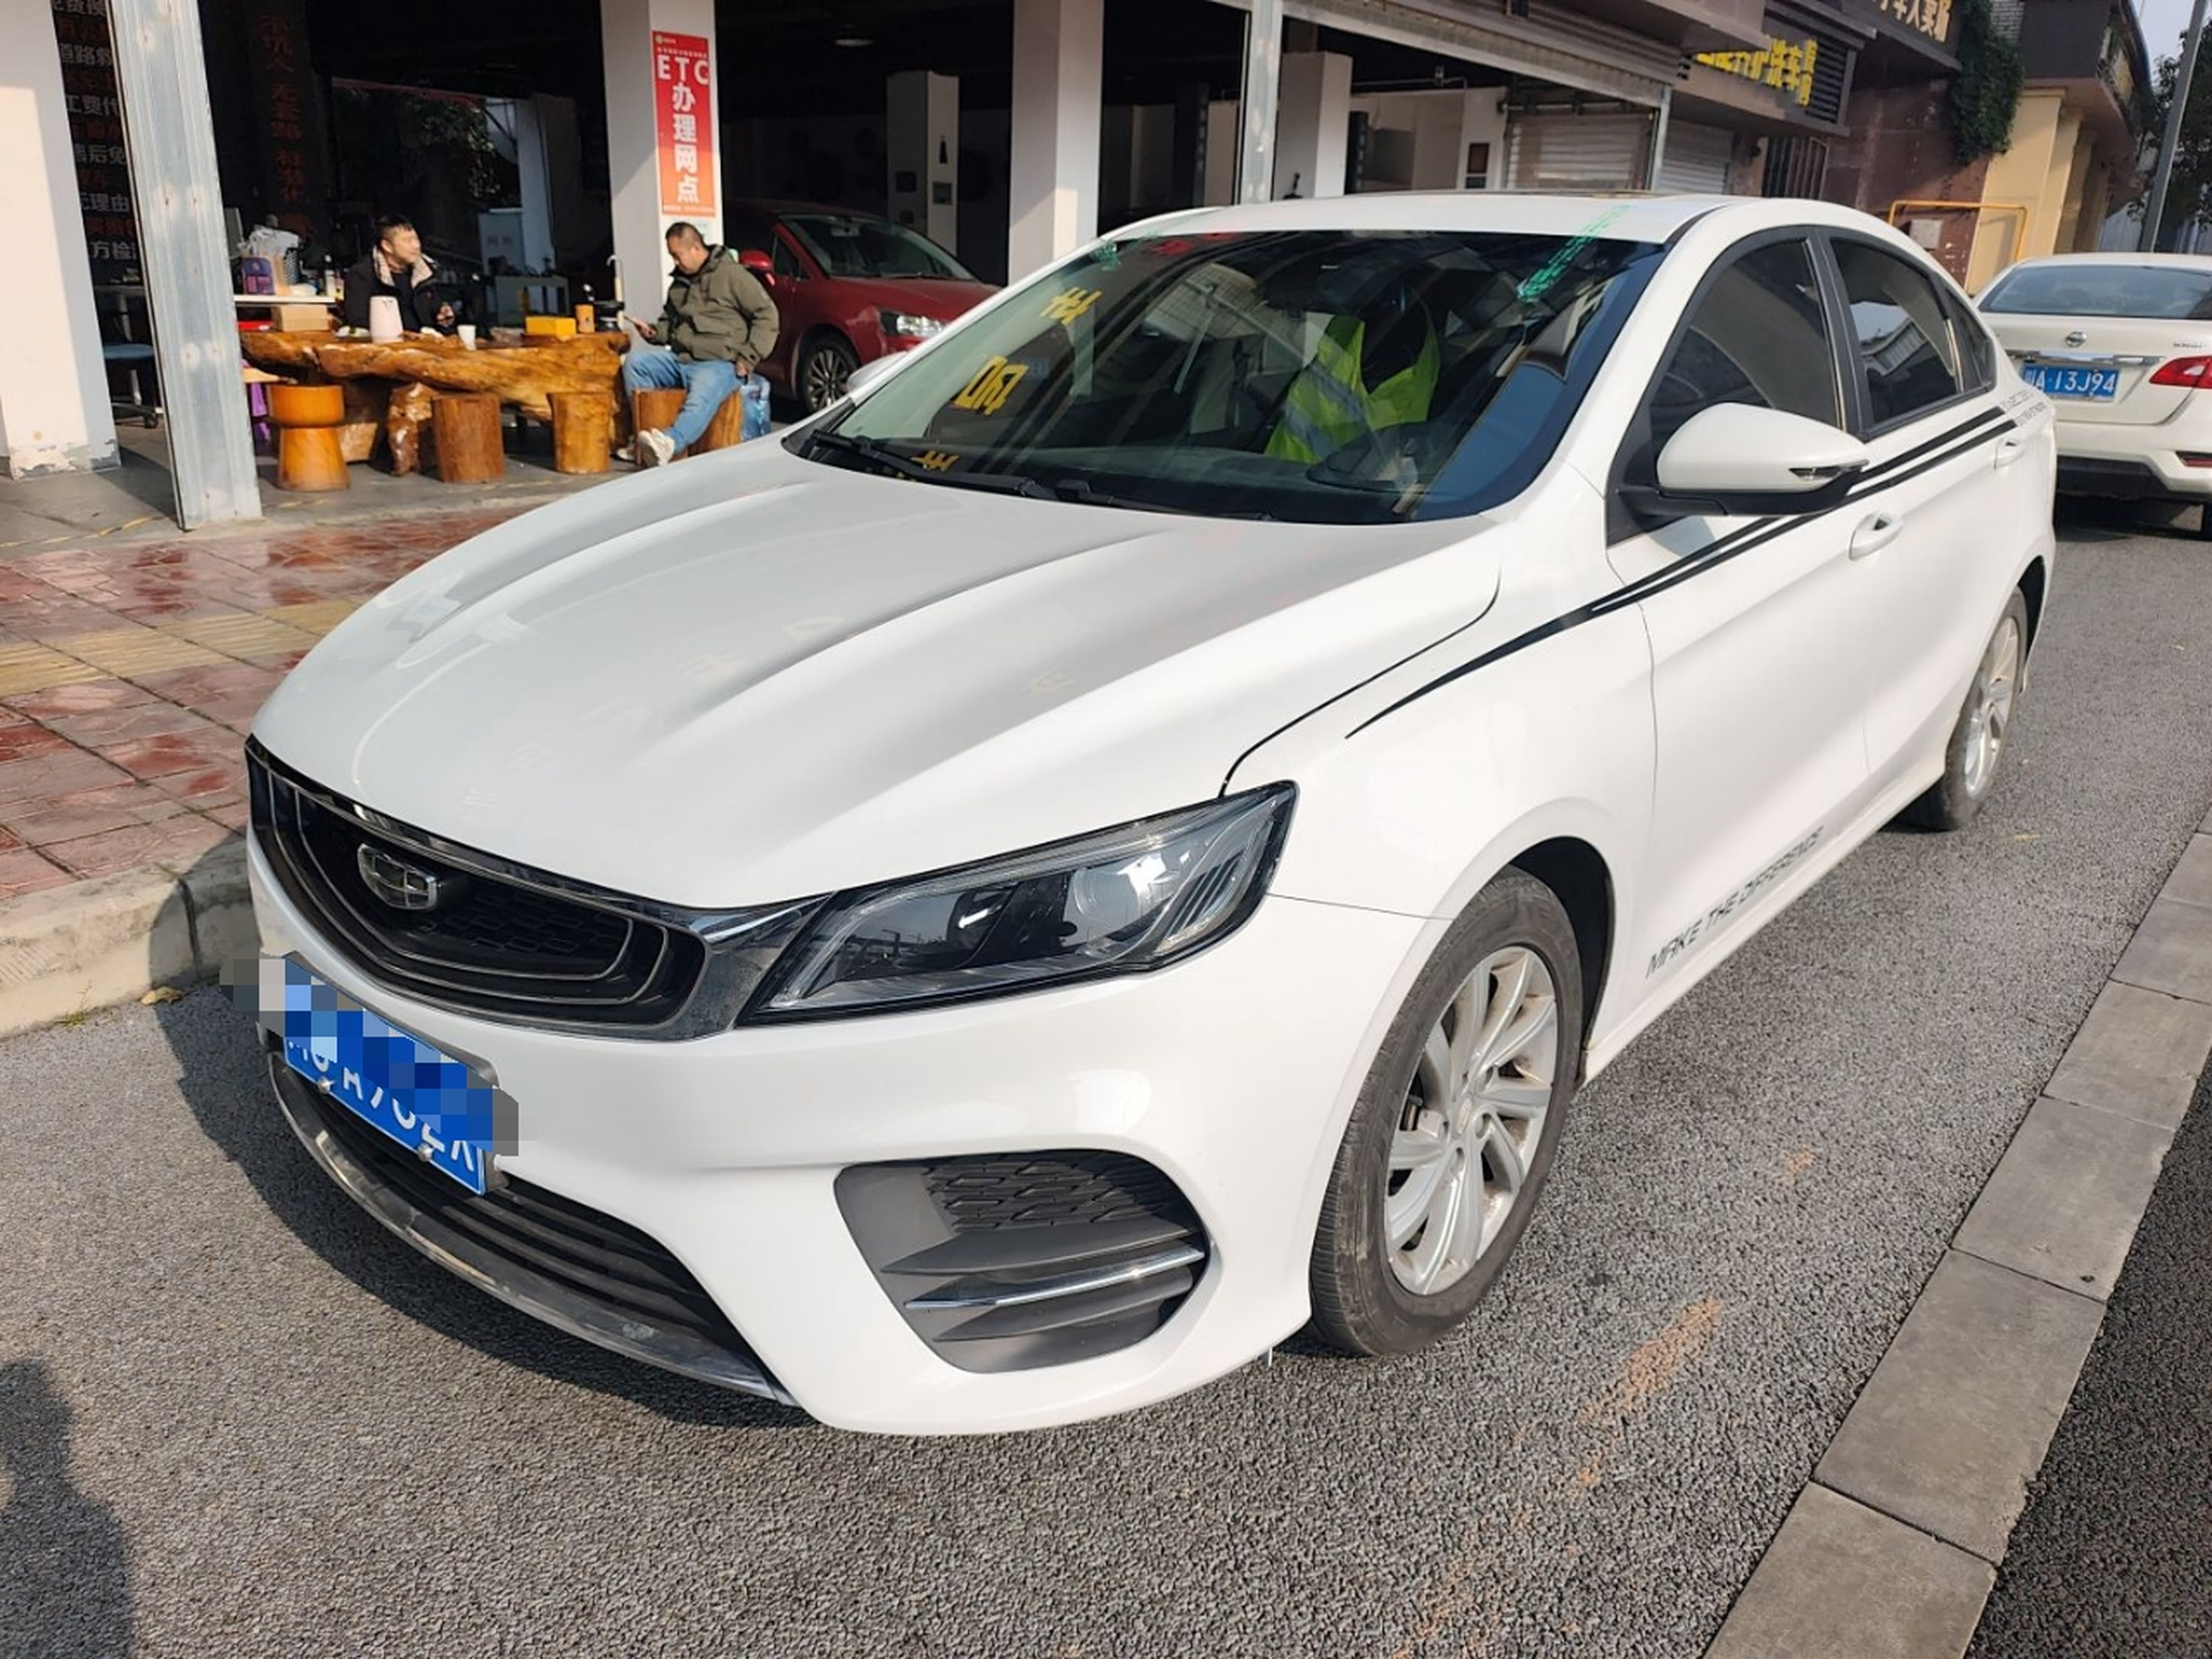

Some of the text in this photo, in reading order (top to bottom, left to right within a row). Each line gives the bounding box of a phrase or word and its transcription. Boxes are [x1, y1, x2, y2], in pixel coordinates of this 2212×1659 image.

[657, 54, 709, 85] ETC
[672, 82, 699, 204] 办理网点
[1646, 919, 1703, 979] MAKE
[1706, 891, 1739, 930] THE
